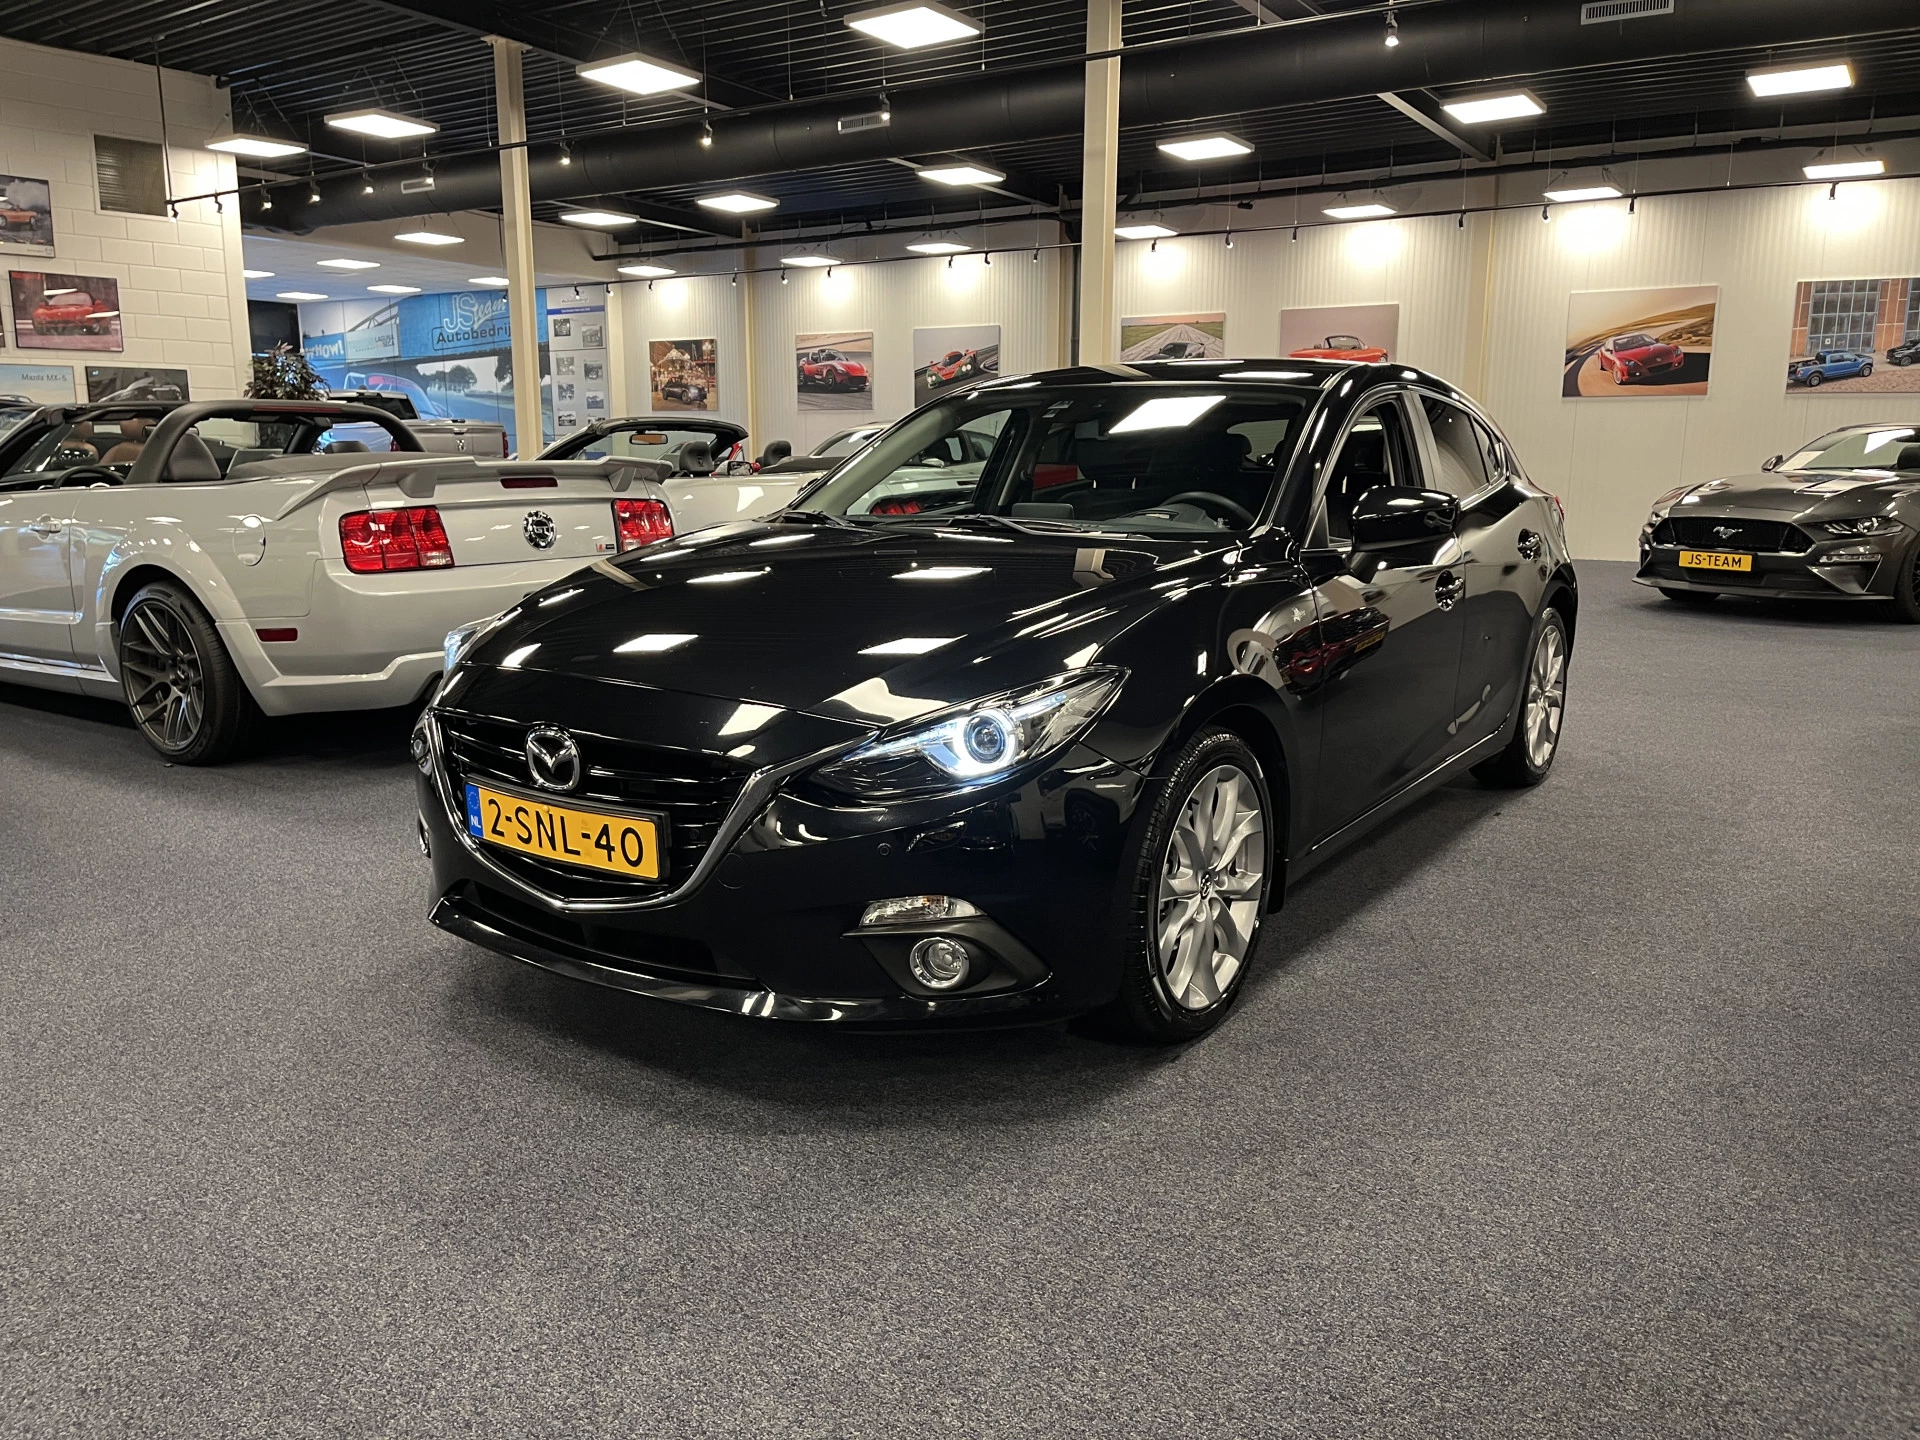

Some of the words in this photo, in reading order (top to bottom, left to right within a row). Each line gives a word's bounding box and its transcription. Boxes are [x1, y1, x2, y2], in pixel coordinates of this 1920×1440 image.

[436, 321, 512, 345] Autobedrij
[21, 373, 44, 381] Mazda
[46, 374, 67, 382] MX-5
[1688, 553, 1742, 568] JS-TEAM
[470, 814, 482, 829] NL
[488, 798, 644, 868] 2-SNL-40
